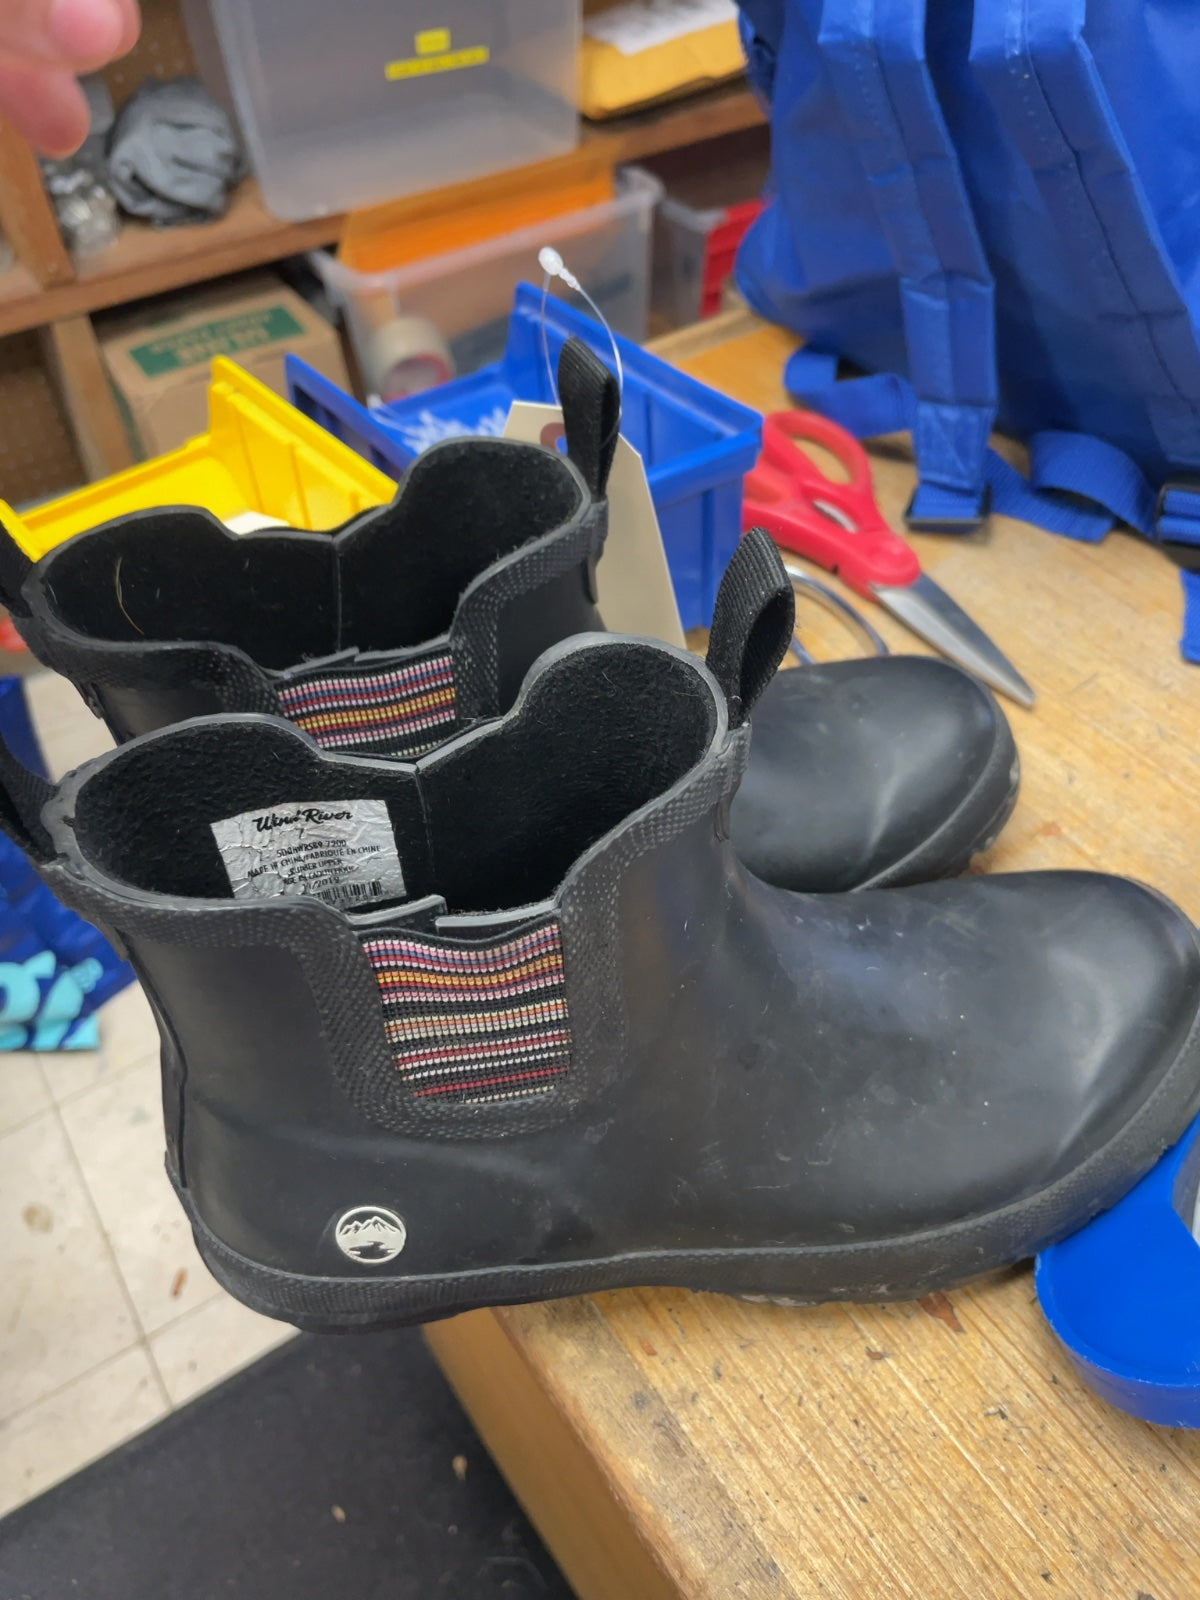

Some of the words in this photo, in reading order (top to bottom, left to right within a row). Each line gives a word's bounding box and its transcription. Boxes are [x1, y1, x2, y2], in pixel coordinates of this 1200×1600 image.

[303, 808, 353, 825] River
[347, 847, 357, 856] EN
[358, 845, 381, 854] CHINE
